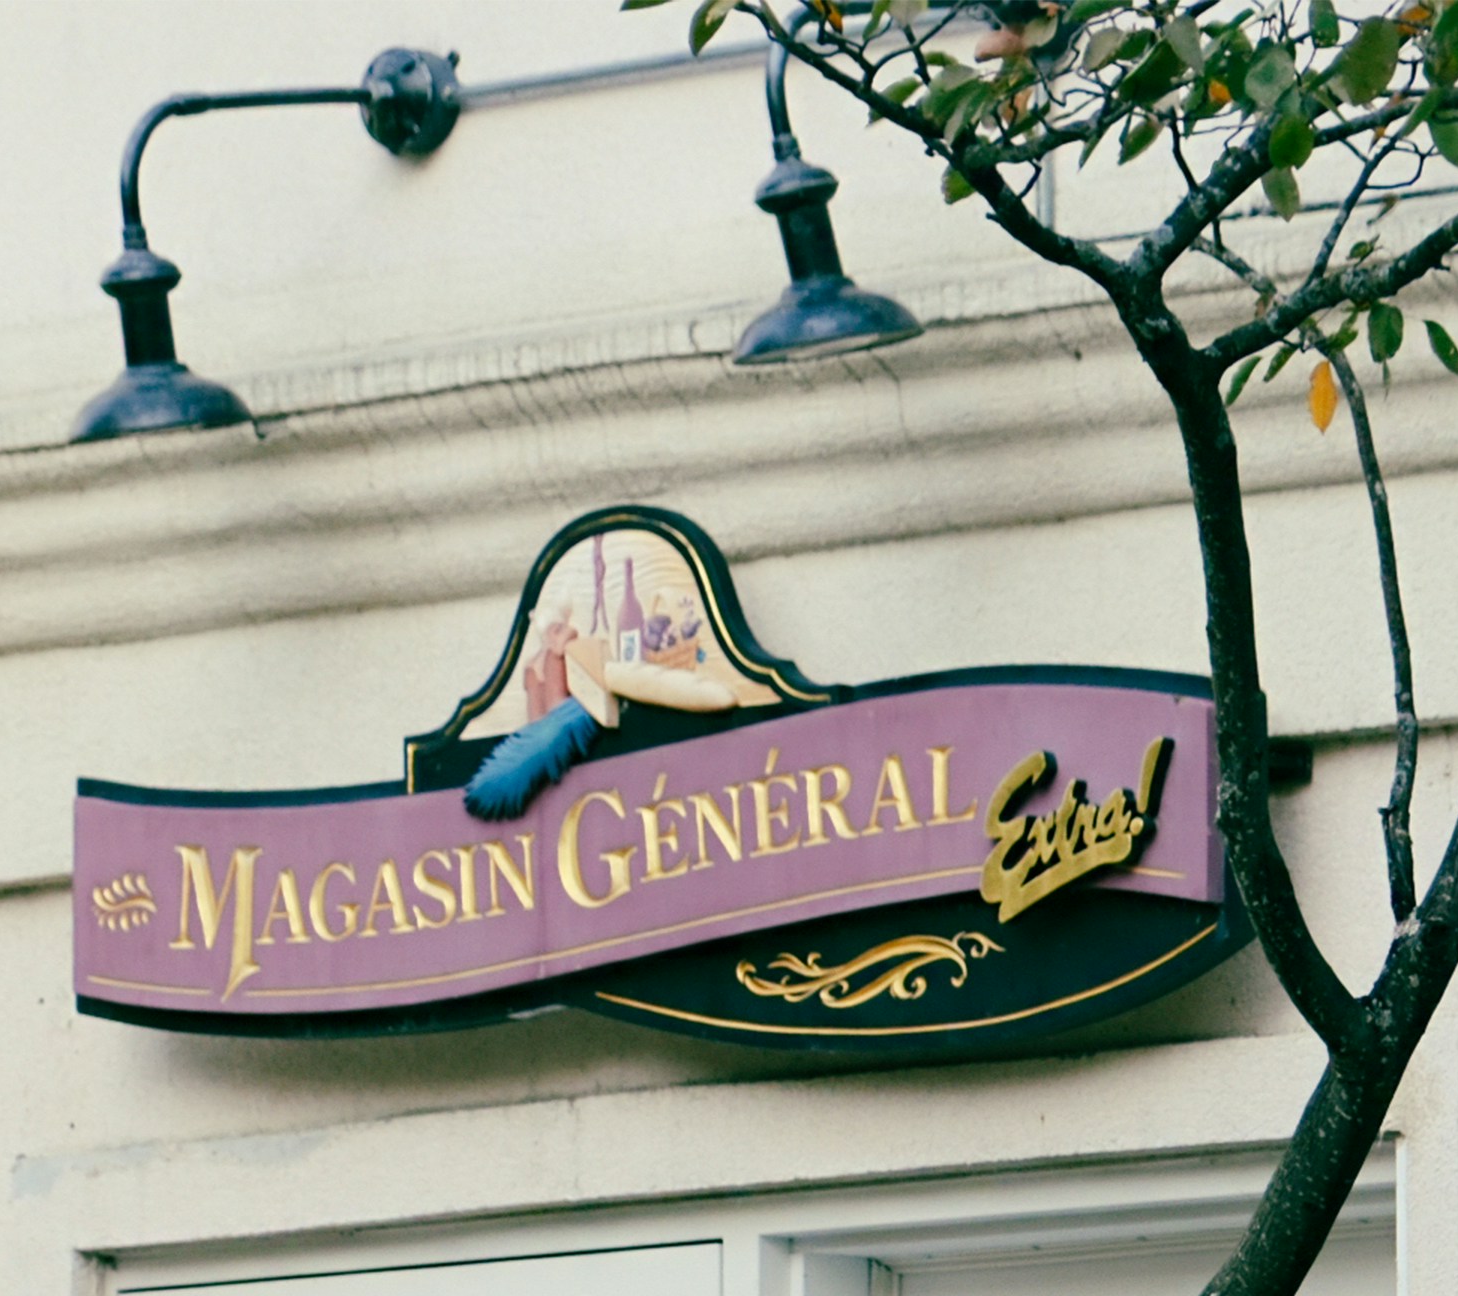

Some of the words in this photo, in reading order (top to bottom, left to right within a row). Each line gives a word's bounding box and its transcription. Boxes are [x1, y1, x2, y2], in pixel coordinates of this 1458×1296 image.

[168, 831, 535, 1003] MAGASIN
[557, 747, 979, 908] GÉNÉRAL
[980, 735, 1168, 924] Extra!
